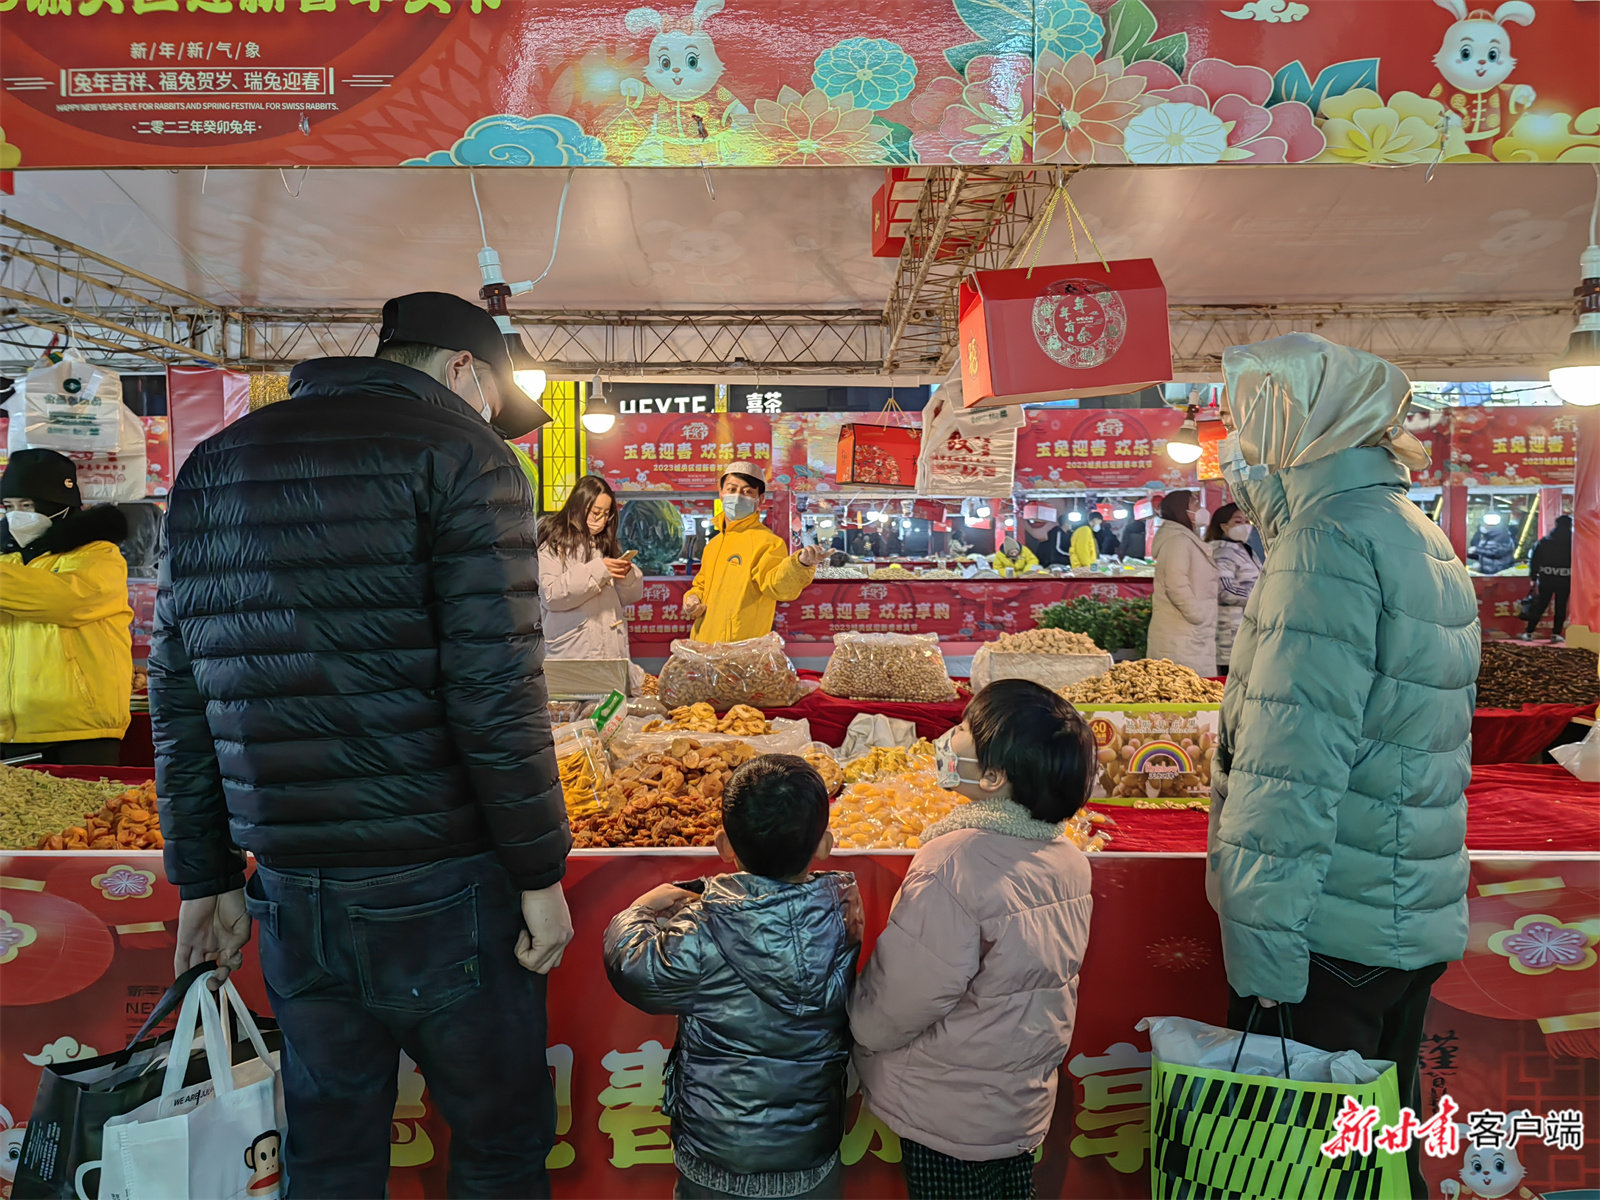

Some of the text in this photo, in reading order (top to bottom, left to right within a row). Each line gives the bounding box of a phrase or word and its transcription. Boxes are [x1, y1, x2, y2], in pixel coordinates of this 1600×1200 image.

[73, 72, 321, 92] 兔年吉祥、福兔贺岁、瑞兔迎春
[124, 103, 138, 111] EVE
[620, 396, 714, 413] HEYTE
[746, 392, 783, 413] 喜茶
[623, 442, 770, 460] 玉兔迎春 欢乐享购
[1036, 440, 1107, 457] 玉兔迎春
[1492, 435, 1564, 454] 玉兔迎春
[800, 601, 950, 620] 玉兔迎春 欢乐享购
